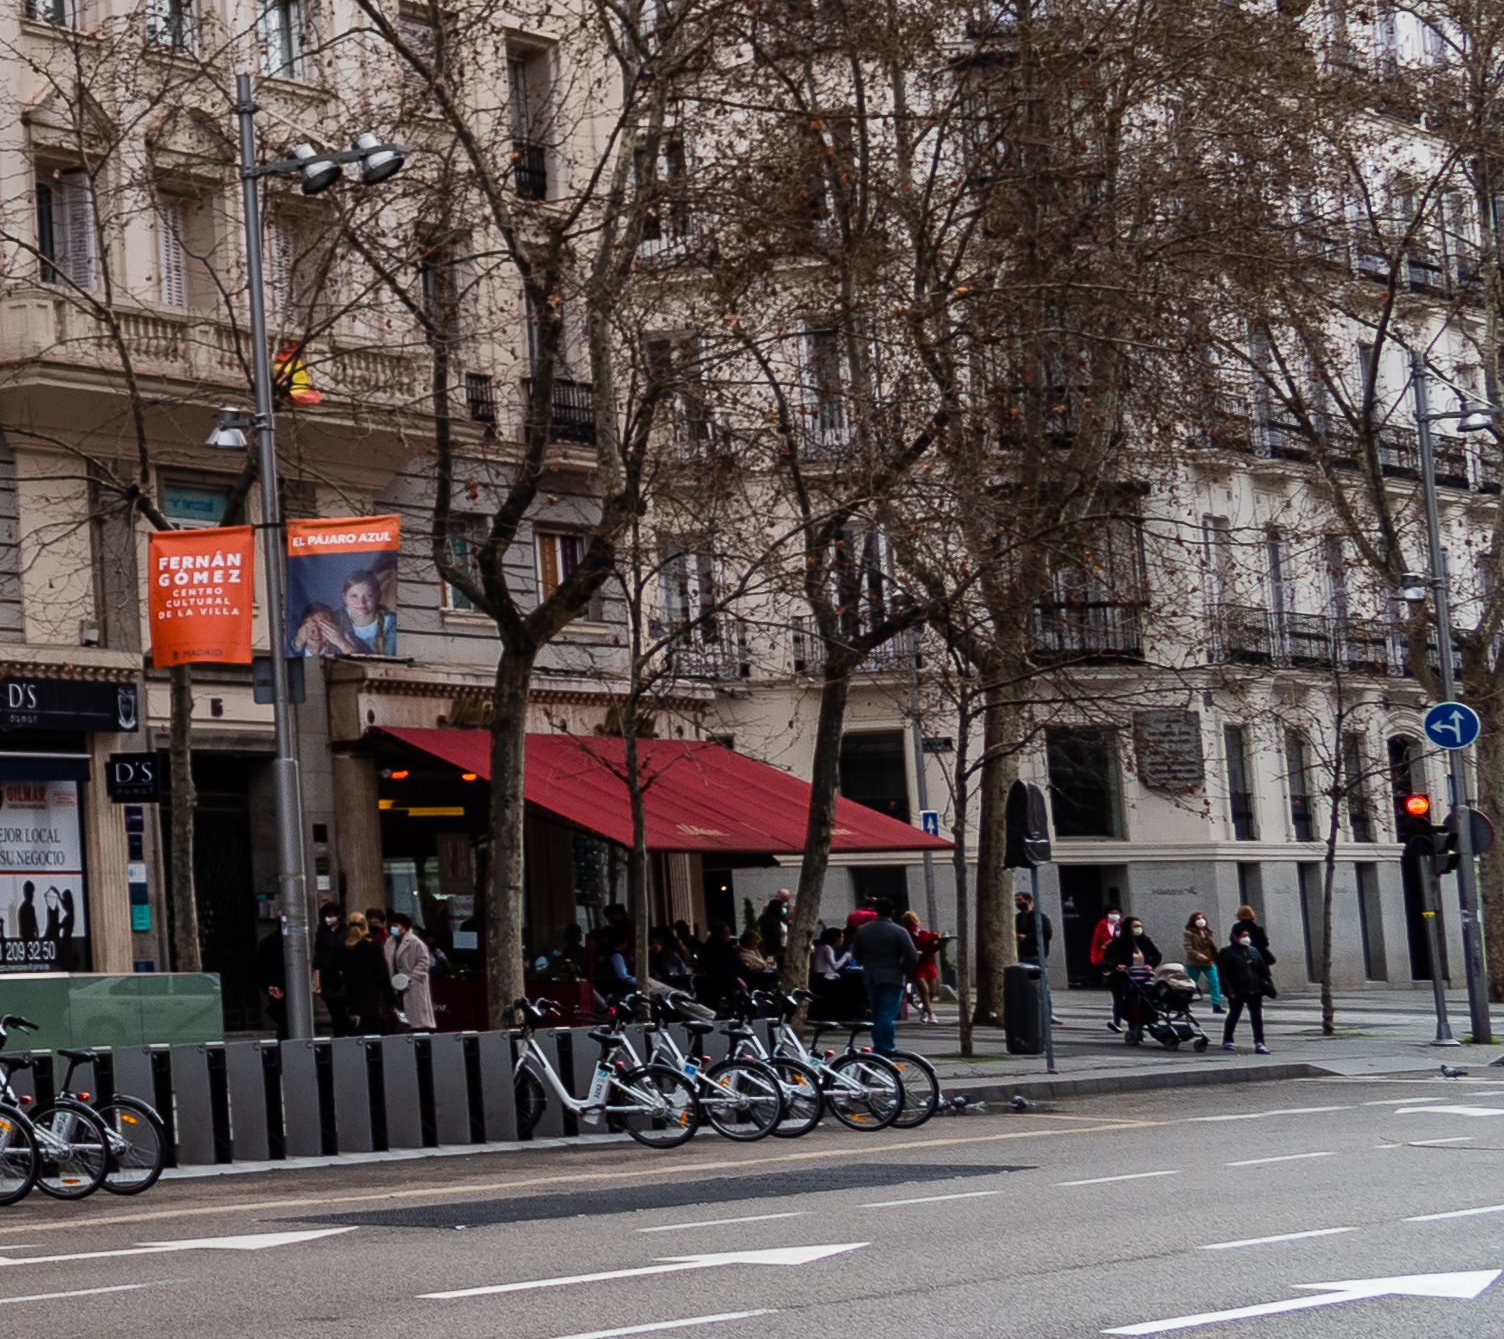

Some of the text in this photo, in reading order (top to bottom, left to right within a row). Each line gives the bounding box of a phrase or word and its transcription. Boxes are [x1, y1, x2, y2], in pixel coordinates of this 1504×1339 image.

[292, 531, 391, 547] EL PÁJARO AZUL
[158, 550, 241, 571] FERNÁN
[158, 568, 241, 587] GÓMEZ
[173, 587, 223, 597] CENTRO
[166, 598, 230, 608] CULTURAL
[158, 607, 239, 619] DE LA VILLA
[8, 683, 37, 709] D'S
[115, 761, 153, 783] D'S
[7, 785, 47, 802] GILMAR
[25, 828, 61, 843] LOCAL
[0, 850, 15, 865] SU
[17, 850, 65, 866] NEGOCIO
[6, 941, 25, 961] 209
[28, 941, 41, 960] 32
[43, 941, 56, 960] 50
